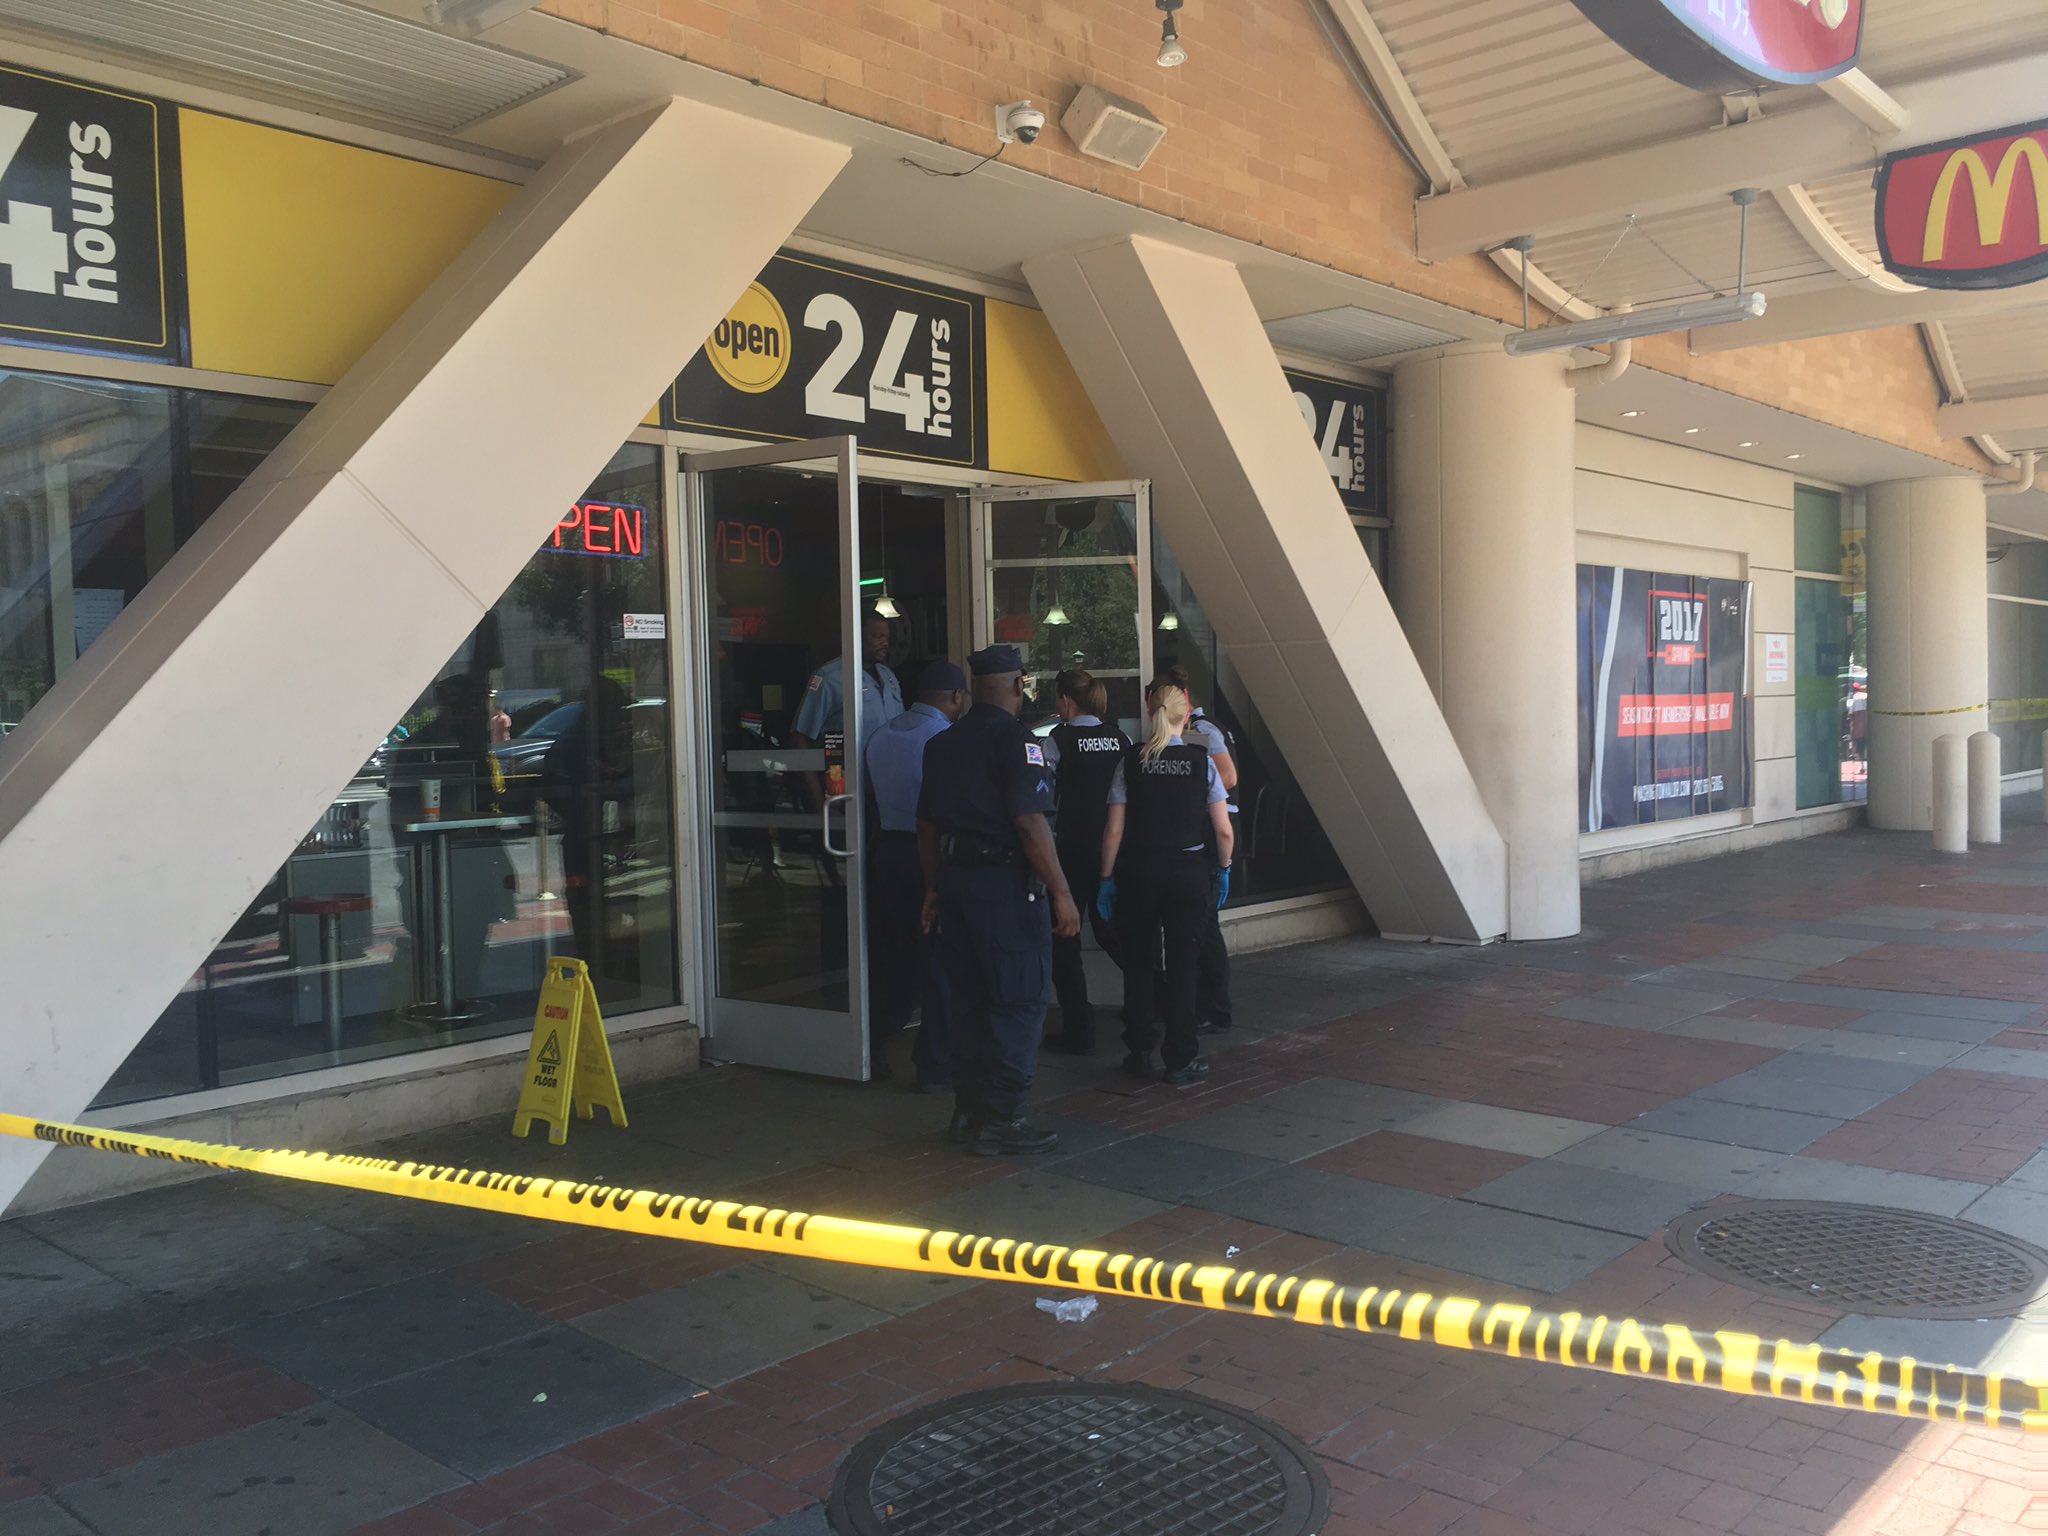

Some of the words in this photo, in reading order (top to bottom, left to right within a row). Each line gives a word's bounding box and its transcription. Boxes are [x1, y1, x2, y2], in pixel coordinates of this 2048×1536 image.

[63, 120, 118, 304] hours
[714, 317, 780, 360] open
[803, 293, 931, 434] 24
[927, 317, 952, 438] hours
[1350, 403, 1366, 493] hours
[552, 503, 641, 555] PEN
[1659, 599, 1704, 642] 2017
[1077, 737, 1120, 752] FORENSICS
[1142, 759, 1192, 776] FORENSICS
[532, 1076, 558, 1089] FLOOR
[540, 1063, 557, 1075] WET
